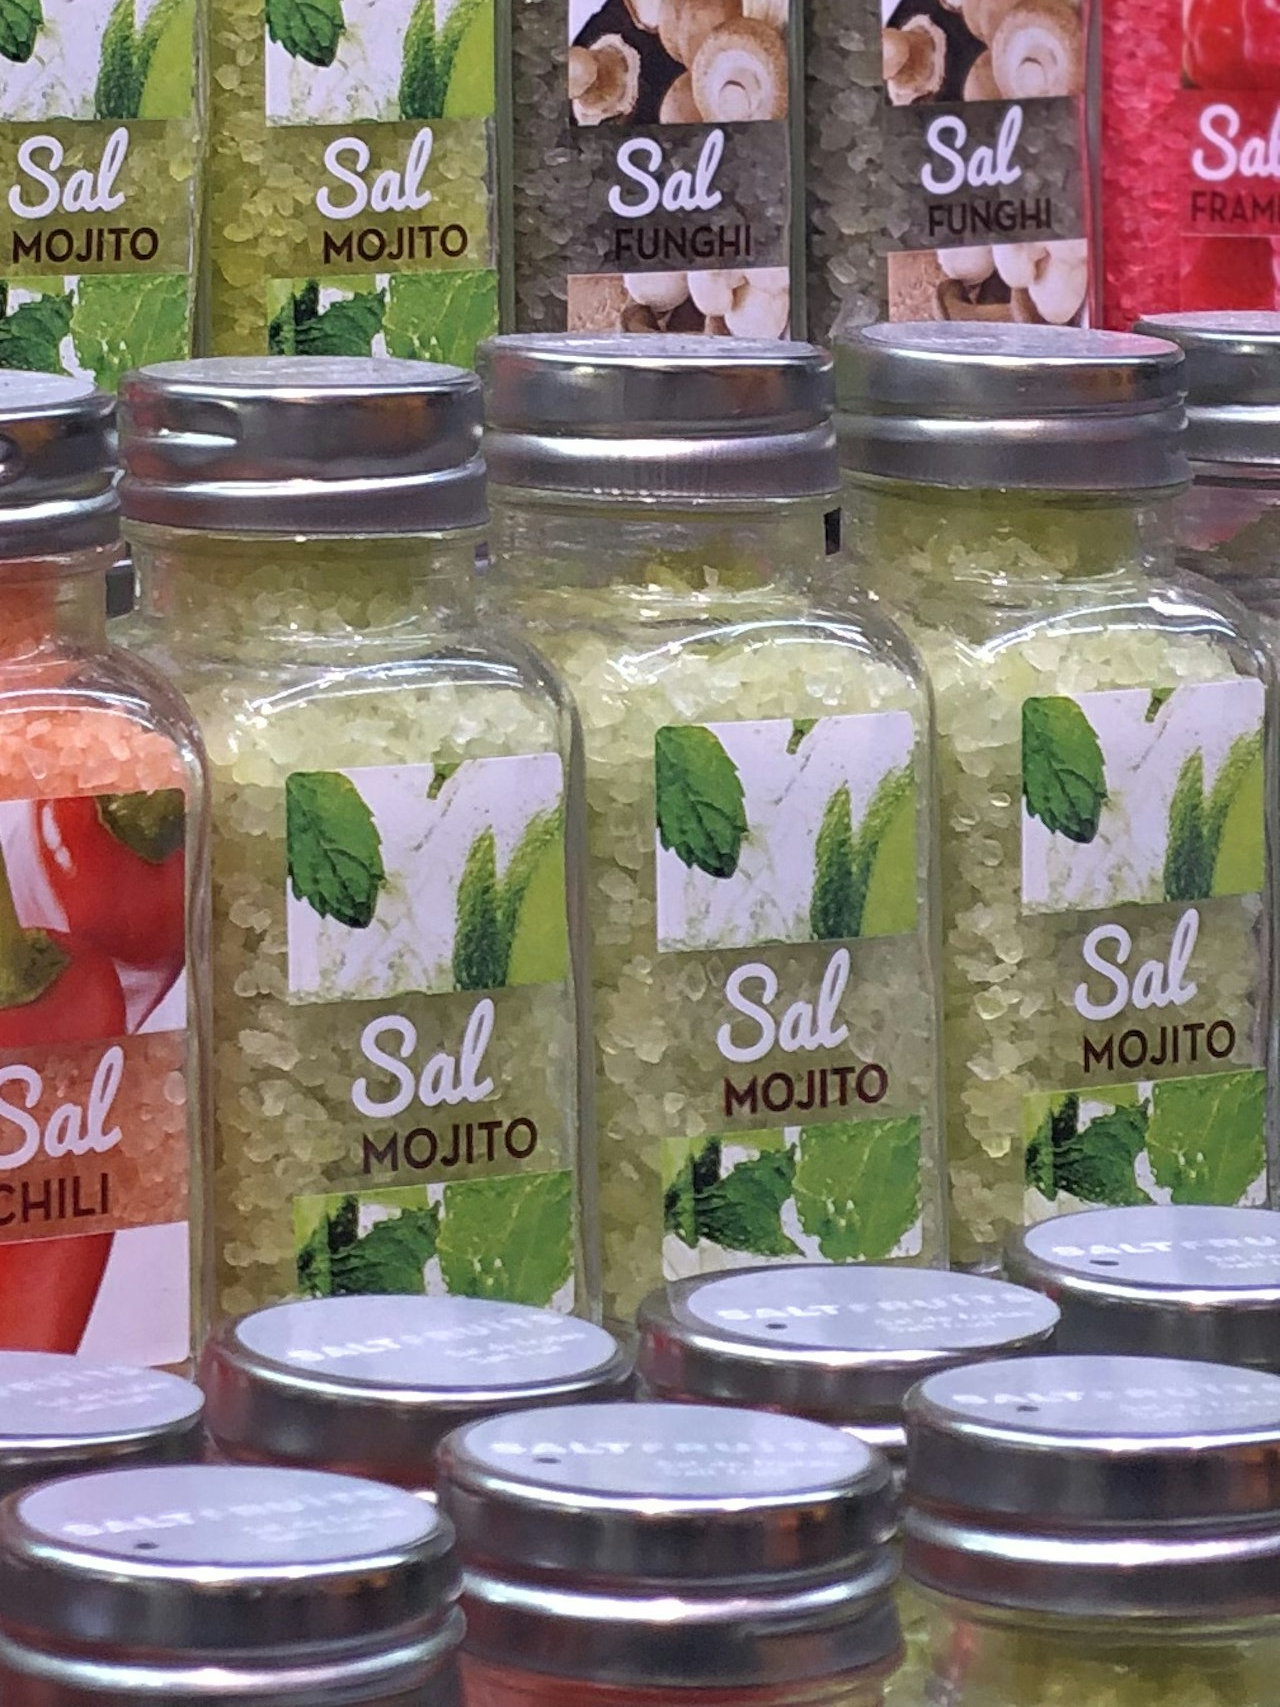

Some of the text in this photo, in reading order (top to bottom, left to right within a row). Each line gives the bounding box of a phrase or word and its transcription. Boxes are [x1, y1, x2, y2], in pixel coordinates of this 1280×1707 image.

[8, 127, 130, 216] Sal
[315, 126, 434, 219] Sal
[608, 129, 724, 217] Sal
[921, 105, 1023, 195] Sal
[12, 227, 159, 265] MOJITO
[323, 225, 469, 264] MOJITO
[614, 224, 752, 261] FUNGHI
[928, 198, 1053, 236] FUNGHI
[1074, 908, 1201, 1022] Sal
[716, 948, 852, 1063] Sal
[352, 998, 495, 1119] Sal
[1082, 1018, 1236, 1073] MOJITO
[723, 1063, 889, 1118] MOJITO
[362, 1116, 538, 1174] MOJITO
